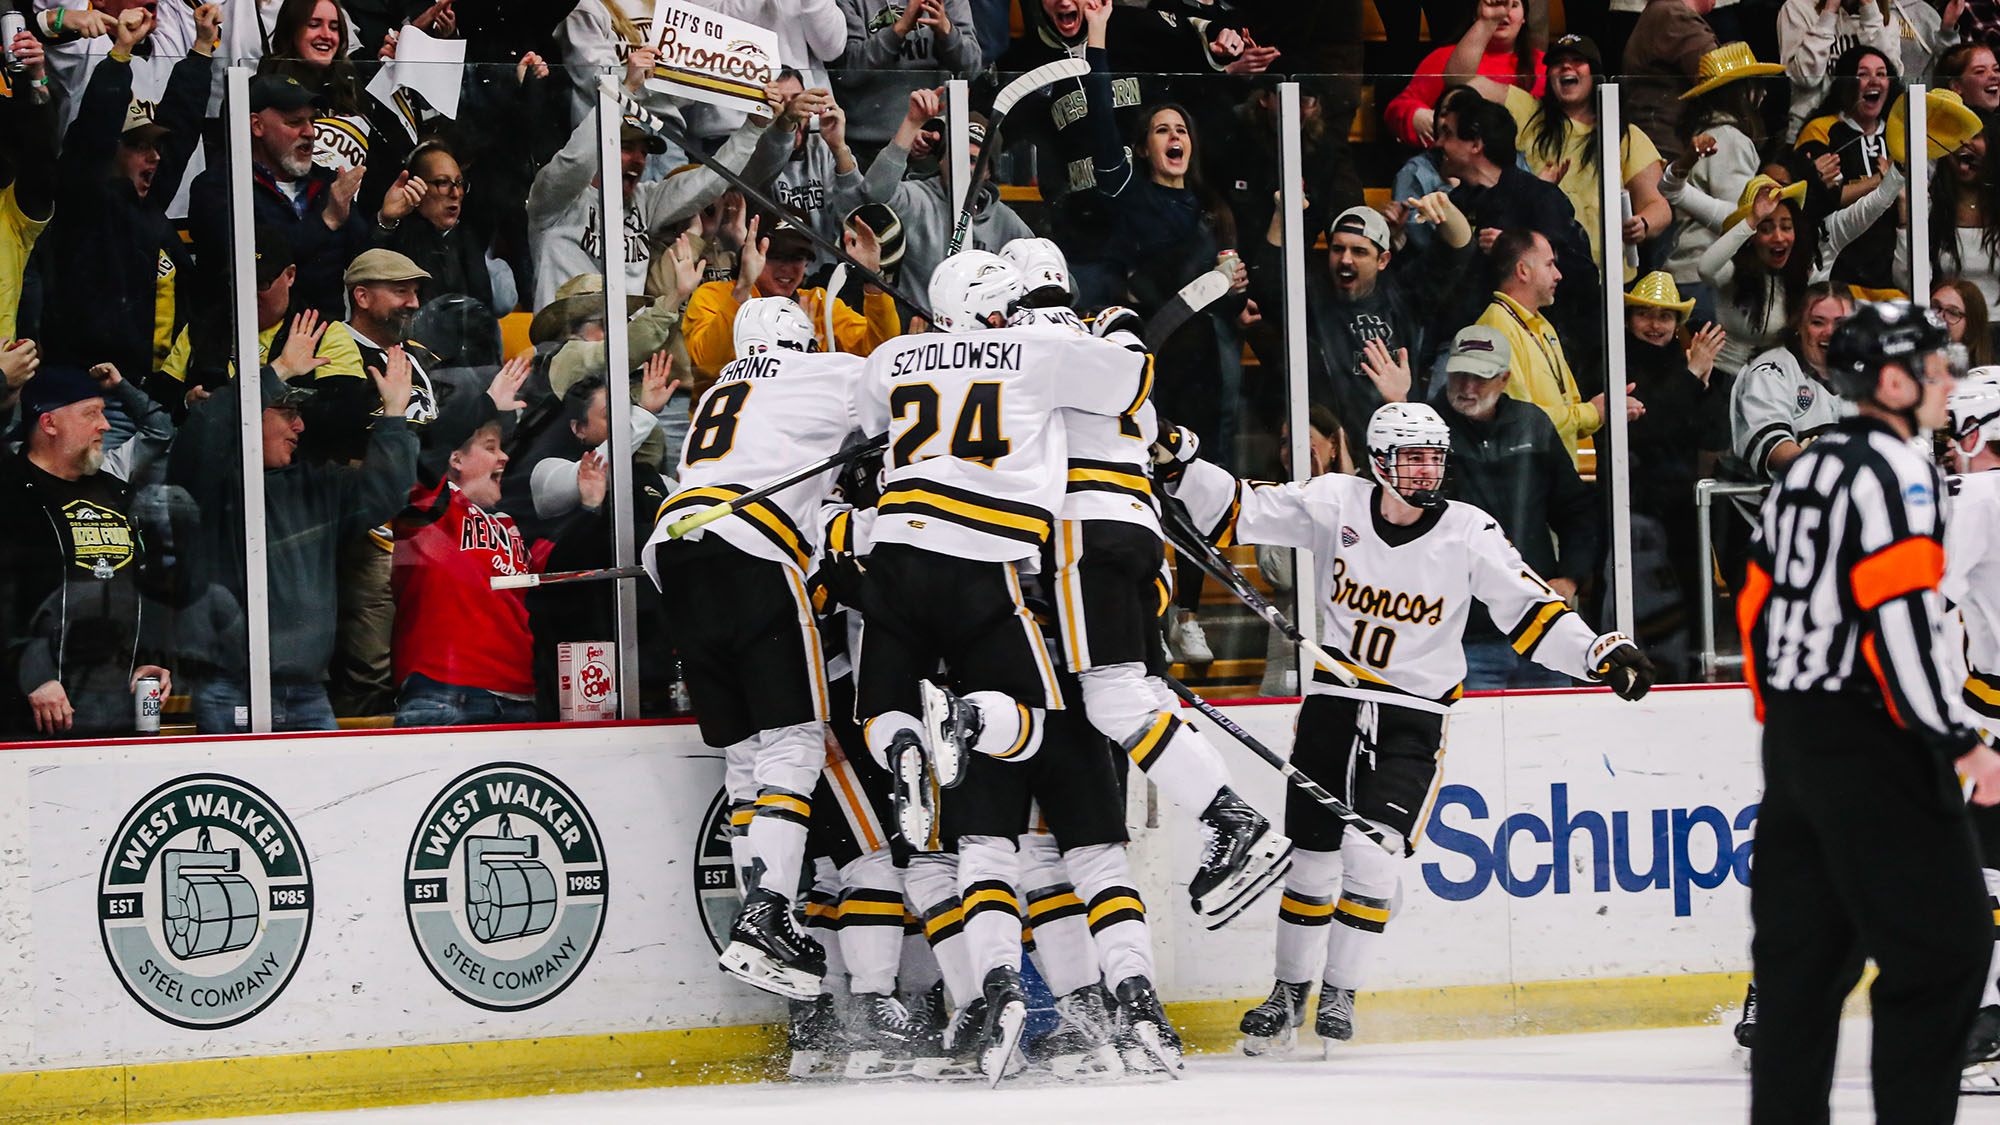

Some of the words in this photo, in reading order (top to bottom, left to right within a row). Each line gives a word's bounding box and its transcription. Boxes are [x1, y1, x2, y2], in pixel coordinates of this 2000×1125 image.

[665, 7, 700, 34] LET'S
[704, 21, 723, 40] GO
[654, 26, 772, 84] Broncos
[1044, 271, 1051, 280] 4
[748, 345, 755, 355] 8
[890, 341, 1022, 377] SZYDLOWSKI
[683, 380, 753, 469] 8
[889, 381, 1012, 471] 24
[1774, 504, 1822, 589] 15
[1330, 557, 1444, 627] Broncos
[1350, 619, 1397, 670] 10
[581, 665, 603, 684] POP
[584, 676, 611, 697] CORN
[120, 802, 179, 871] WEST
[185, 793, 286, 865] WALKER
[425, 789, 480, 857] WEST
[486, 781, 581, 851] WALKER
[414, 884, 440, 899] EST
[569, 875, 601, 891] 1985
[704, 870, 728, 885] EST
[109, 898, 135, 914] EST
[272, 889, 306, 906] 1985
[139, 959, 183, 1003] STEEL
[190, 952, 280, 1008] COMPANY
[444, 942, 486, 985] STEEL
[492, 935, 577, 990] COMPANY
